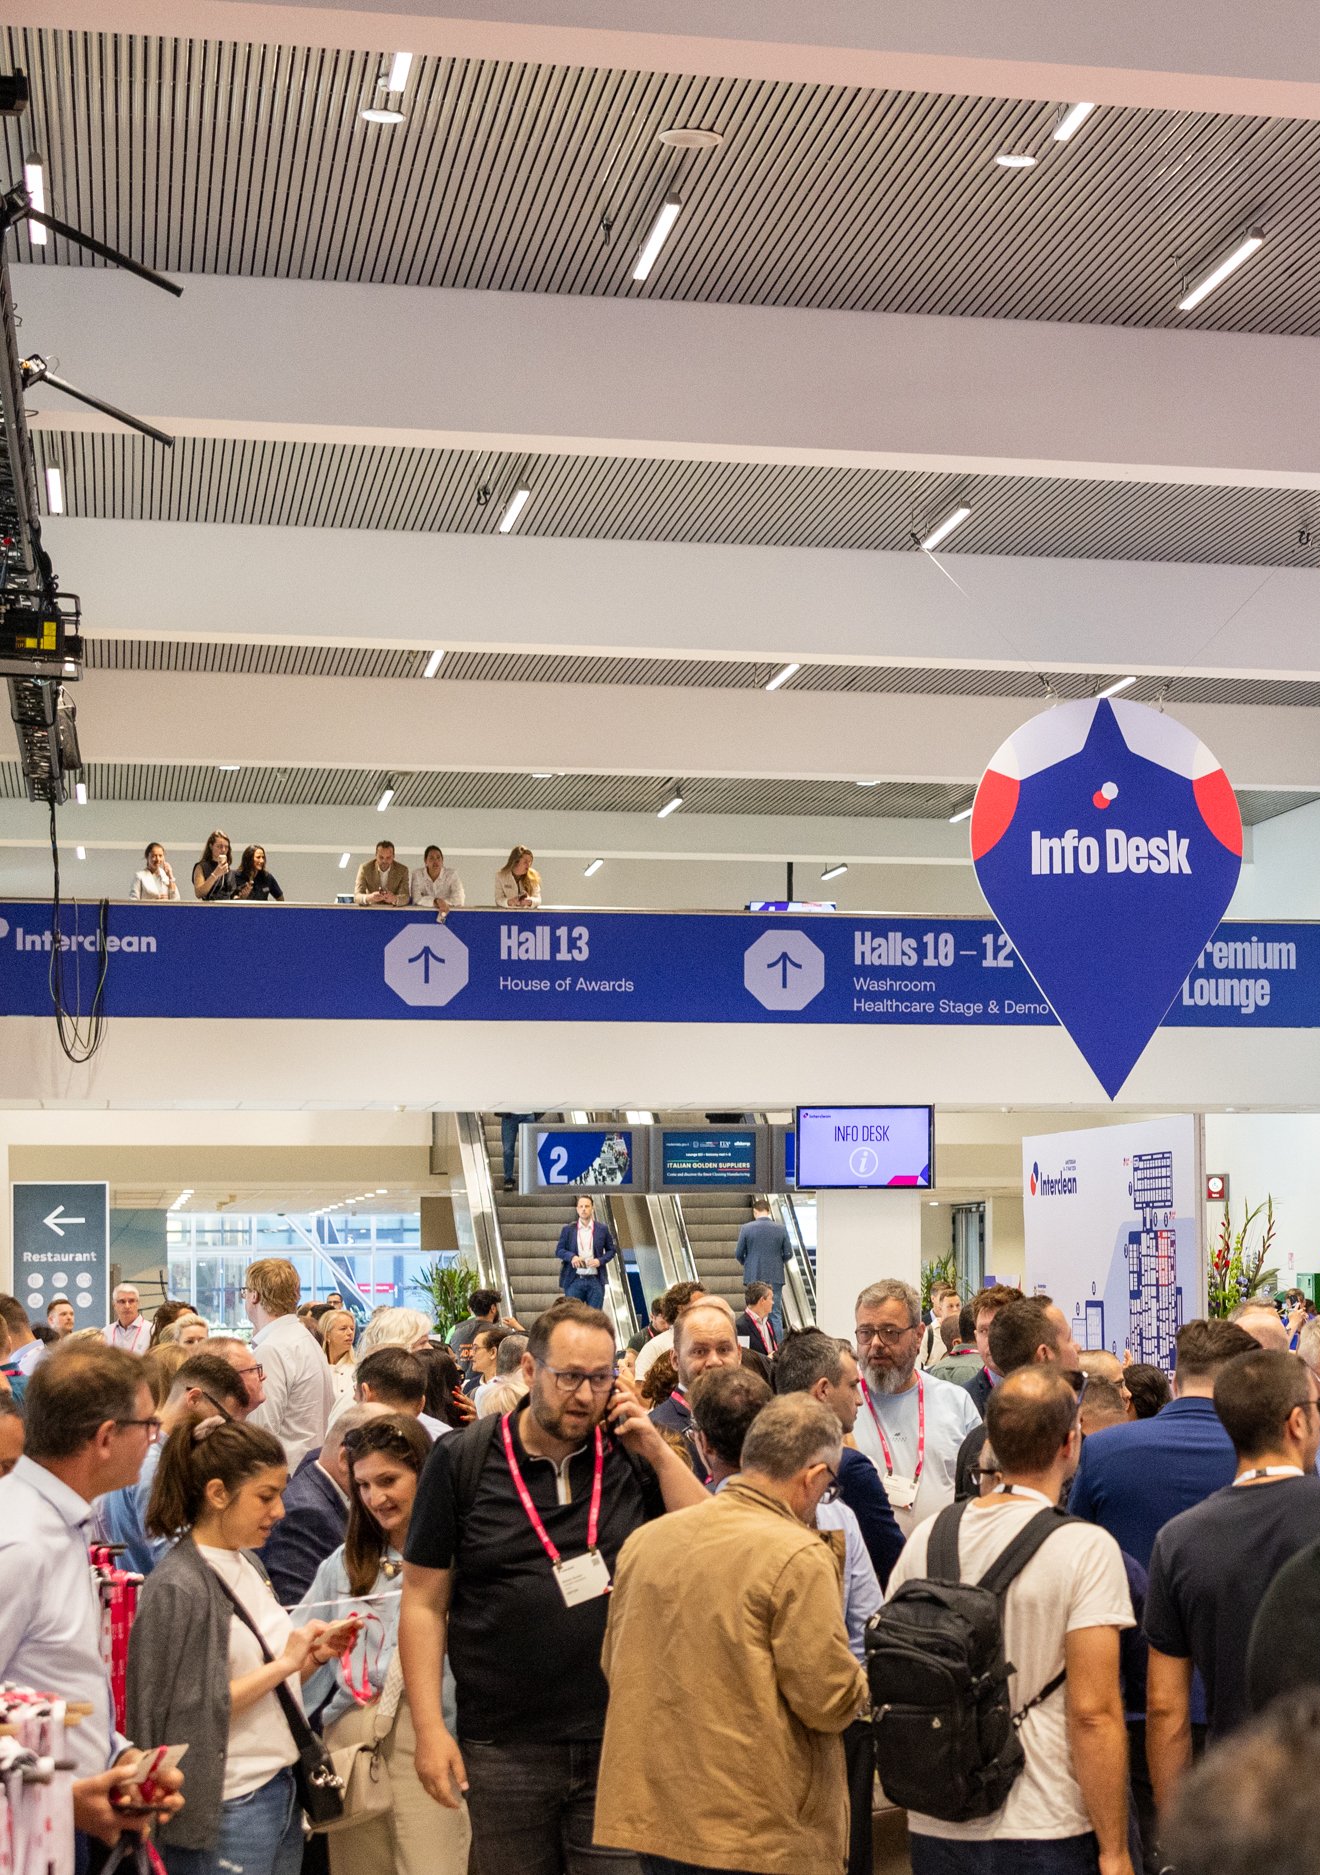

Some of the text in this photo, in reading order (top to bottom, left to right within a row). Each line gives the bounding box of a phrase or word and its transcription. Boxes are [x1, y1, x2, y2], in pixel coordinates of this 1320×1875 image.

[1031, 829, 1193, 875] Info Desk
[16, 927, 157, 953] Interclean
[500, 925, 590, 961] Hall 13
[854, 931, 918, 967] Halls
[923, 932, 955, 967] 10
[982, 933, 1014, 968] 12
[1197, 935, 1297, 970] remium
[500, 976, 635, 992] House of Awards
[853, 977, 936, 992] Washroom
[1182, 974, 1271, 1014] Lounge
[853, 998, 1050, 1016] Healthcare Stage & Demo
[834, 1125, 890, 1142] INFO DESK
[549, 1146, 569, 1184] 2
[1040, 1170, 1078, 1197] Interclean
[23, 1251, 97, 1262] Restaurant
